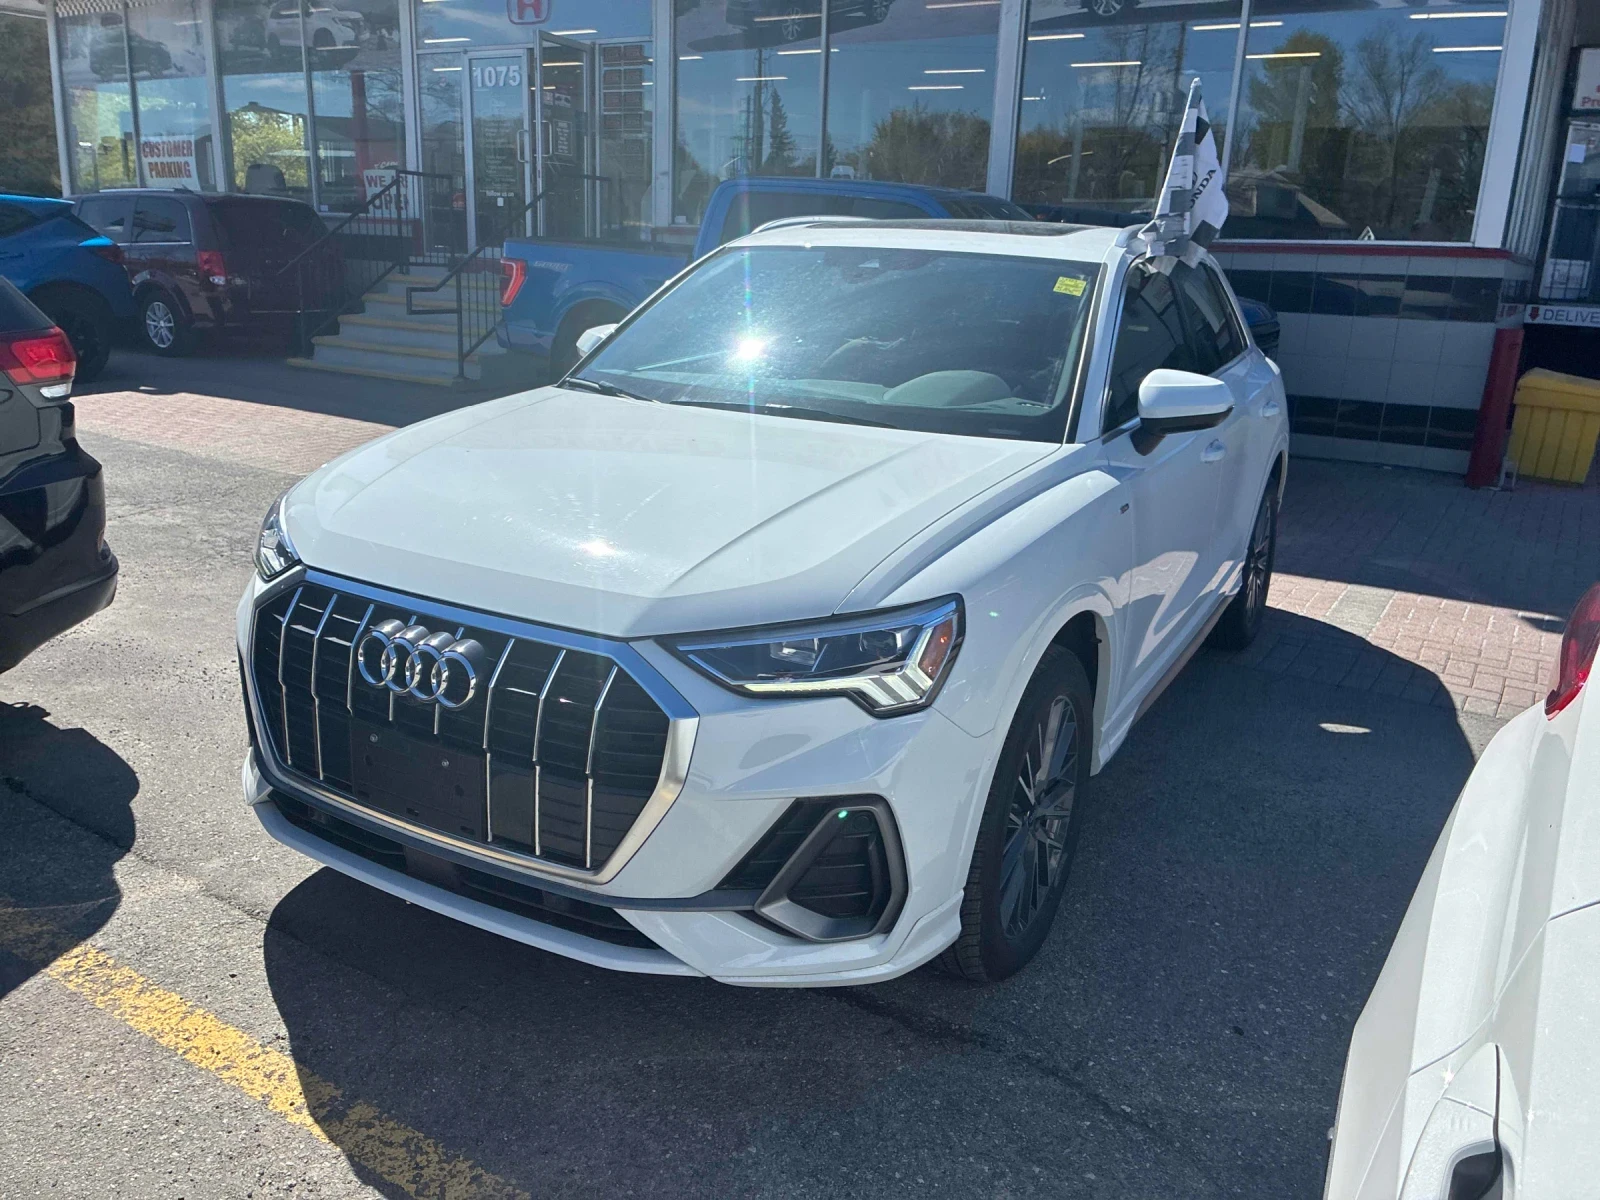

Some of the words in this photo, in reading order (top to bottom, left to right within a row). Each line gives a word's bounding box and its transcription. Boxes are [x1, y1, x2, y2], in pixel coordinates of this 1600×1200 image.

[473, 65, 521, 87] 1075
[142, 140, 193, 158] CUSTOMER
[148, 161, 192, 178] PARKING
[366, 175, 386, 187] WE
